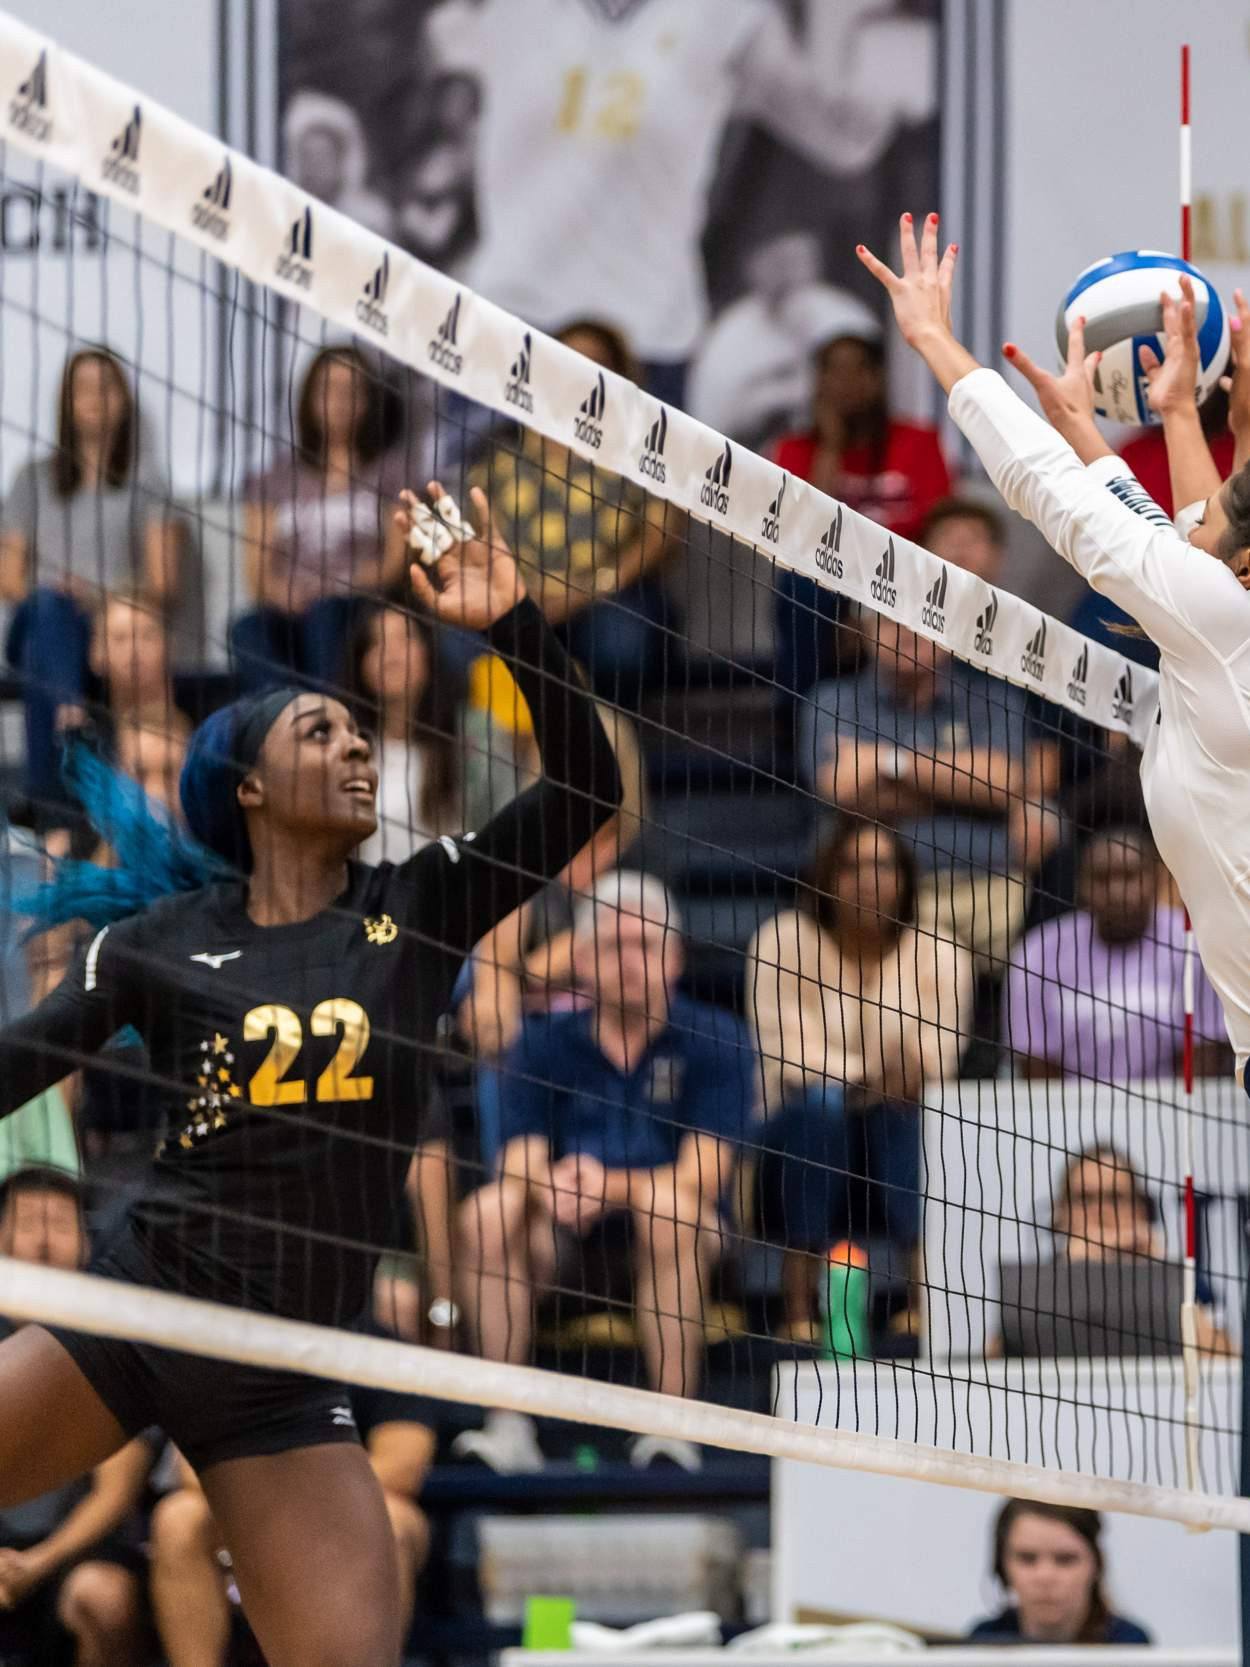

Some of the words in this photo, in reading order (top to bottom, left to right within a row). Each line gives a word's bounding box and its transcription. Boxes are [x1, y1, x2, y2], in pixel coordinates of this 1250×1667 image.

[815, 546, 844, 579] adidas
[870, 578, 897, 608] adidas
[243, 997, 374, 1107] 22
